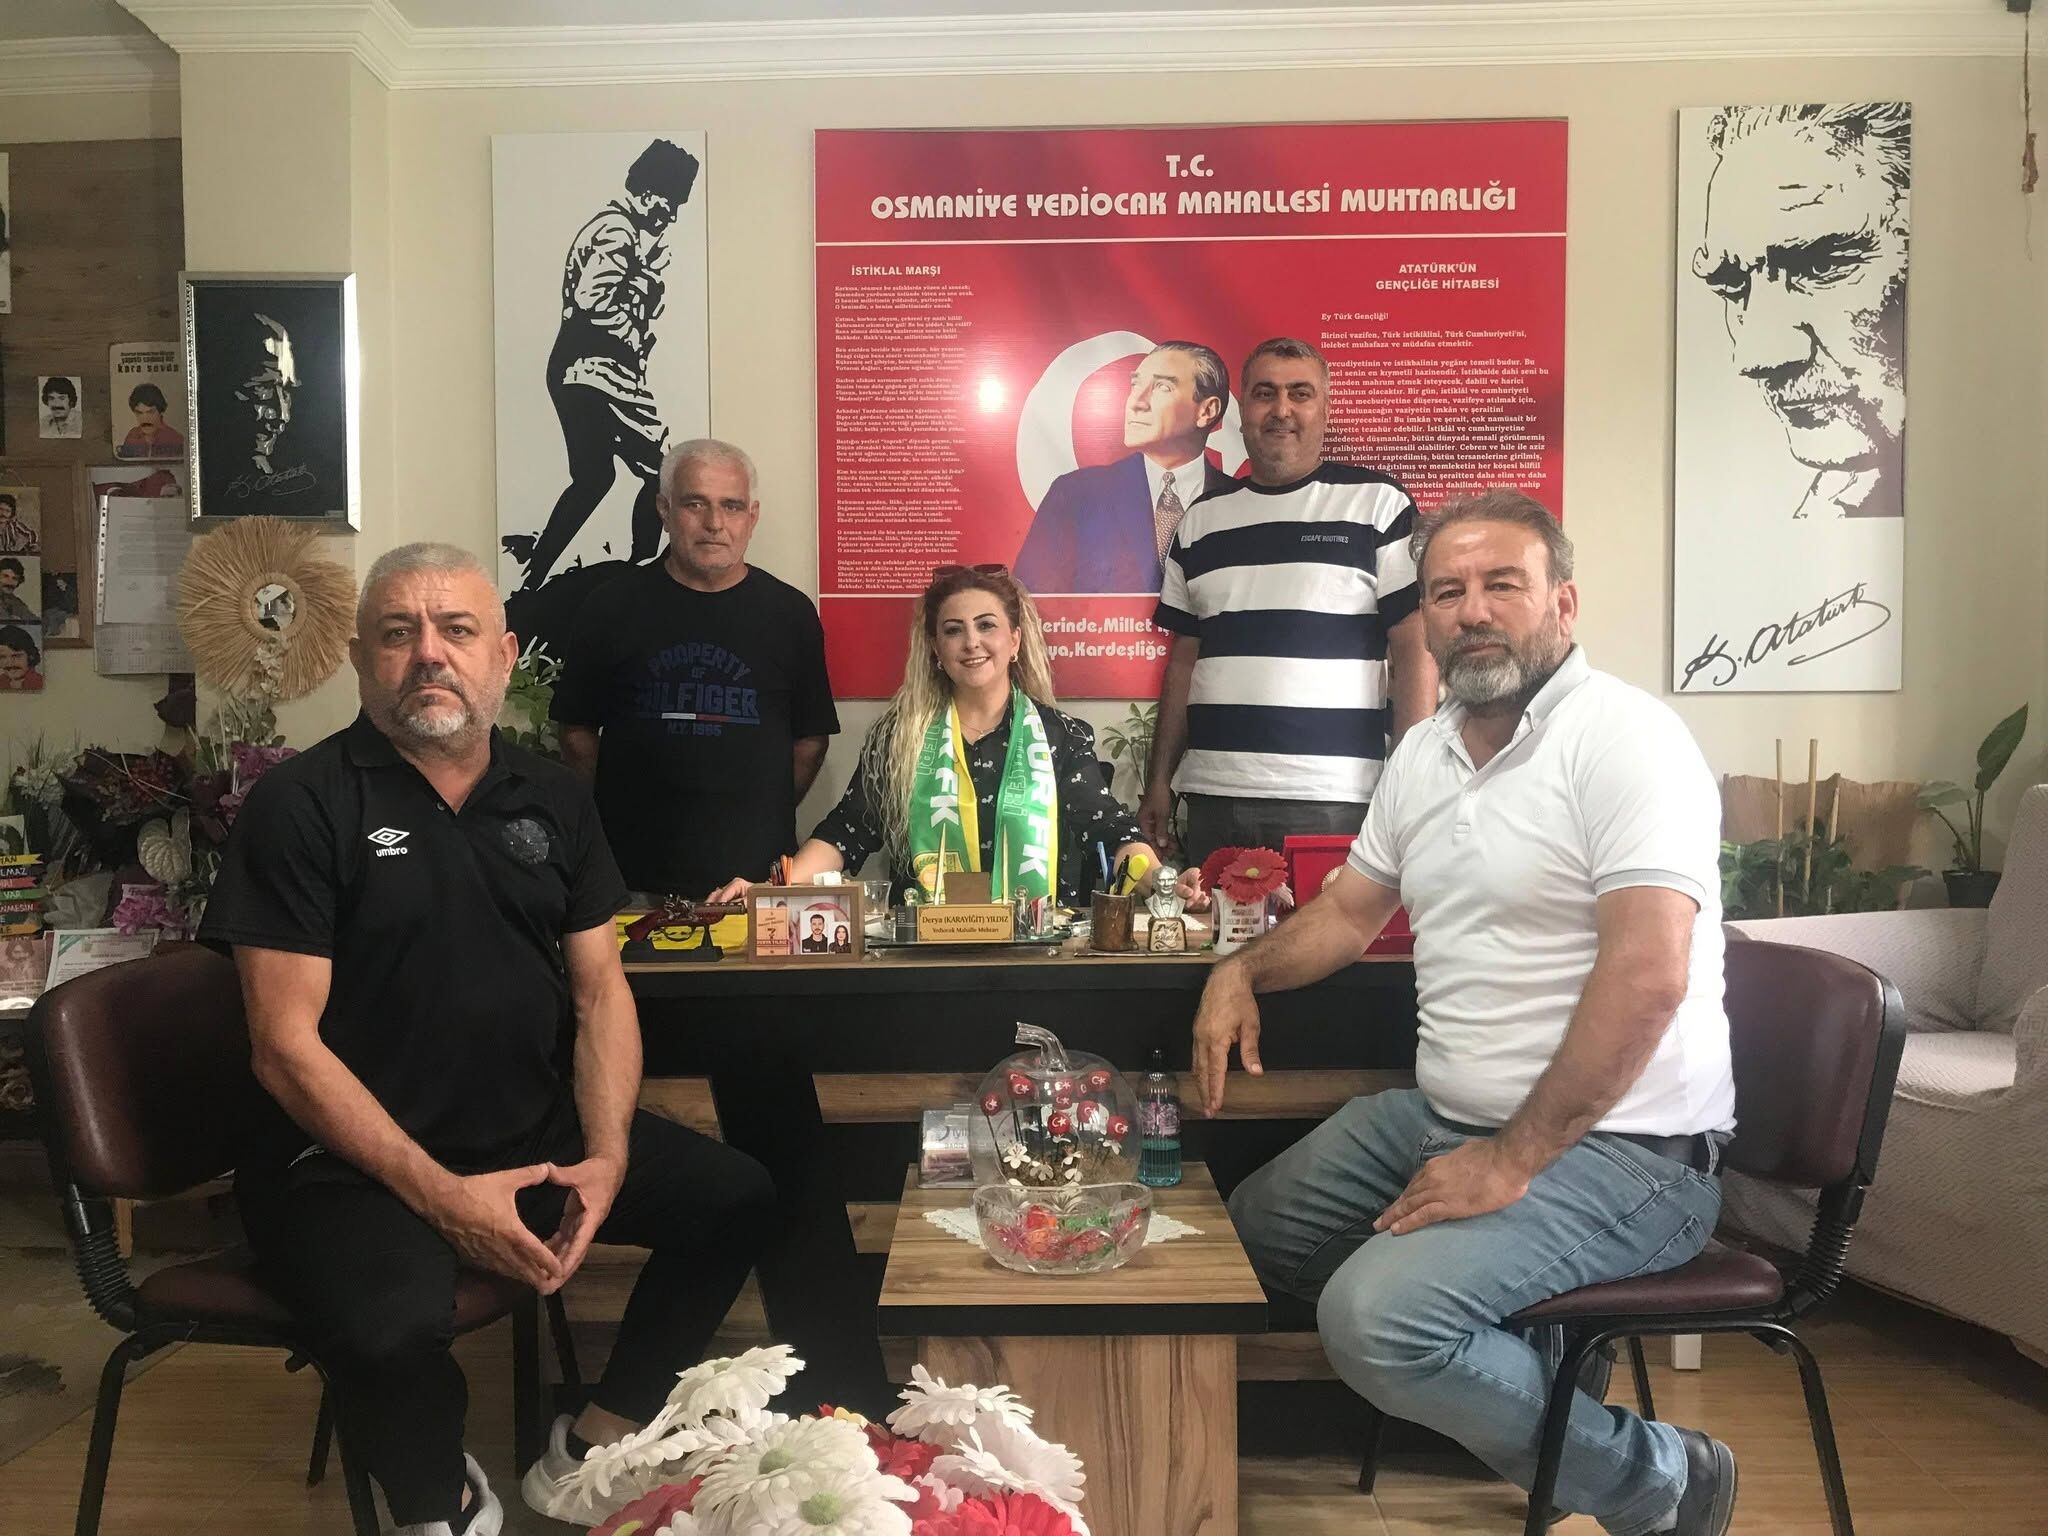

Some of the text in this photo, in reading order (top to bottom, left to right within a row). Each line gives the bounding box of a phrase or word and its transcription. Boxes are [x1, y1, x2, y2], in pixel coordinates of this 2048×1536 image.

[1165, 154, 1214, 178] T.C.
[871, 180, 1516, 219] OSMANİYE YEDİOCAK MAHALLESİ MUHTARLIĞI
[851, 265, 941, 277] İSTİKLAL MARŞI
[1375, 278, 1500, 291] GENÇLİĞE HİTABESİ
[1321, 313, 1332, 321] Ey
[1354, 312, 1389, 321] Gençliği!
[1350, 331, 1380, 340] vazifen,
[1326, 359, 1380, 368] evcudiyetinin
[1380, 369, 1412, 377] kıymetli
[1424, 378, 1462, 386] isteyecek,
[1422, 387, 1438, 396] gün,
[1482, 386, 1528, 395] cumhuriyeti
[1356, 397, 1411, 406] mecburiyetine
[1414, 397, 1450, 405] düşersen,
[1453, 396, 1484, 405] vazifeye
[1519, 396, 1536, 404] için,
[1346, 407, 1392, 415] bulunacağın
[1396, 406, 1430, 415] vaziyetin
[1472, 406, 1503, 414] şeraitini
[1445, 415, 1469, 424] şerait,
[1472, 415, 1485, 424] çok
[1325, 426, 1359, 434] ahiyette
[1468, 424, 1525, 433] cumhuriyetine
[1367, 435, 1409, 443] düşmanlar,
[1437, 434, 1469, 443] dünyada
[1500, 434, 1545, 442] görülmemiş
[1333, 444, 1373, 453] galibiyetin
[1510, 452, 1542, 461] girilmiş,
[1378, 462, 1416, 471] dağıtılmış
[1440, 472, 1474, 480] şeraitten
[1446, 481, 1484, 489] dahilinde,
[1520, 480, 1540, 489] sahip
[1039, 617, 1152, 634] lerinde,Millet
[1047, 641, 1167, 660] ya,Kardeşliğe
[929, 767, 960, 829] FK
[375, 846, 408, 858] umbro
[922, 916, 942, 924] Derya
